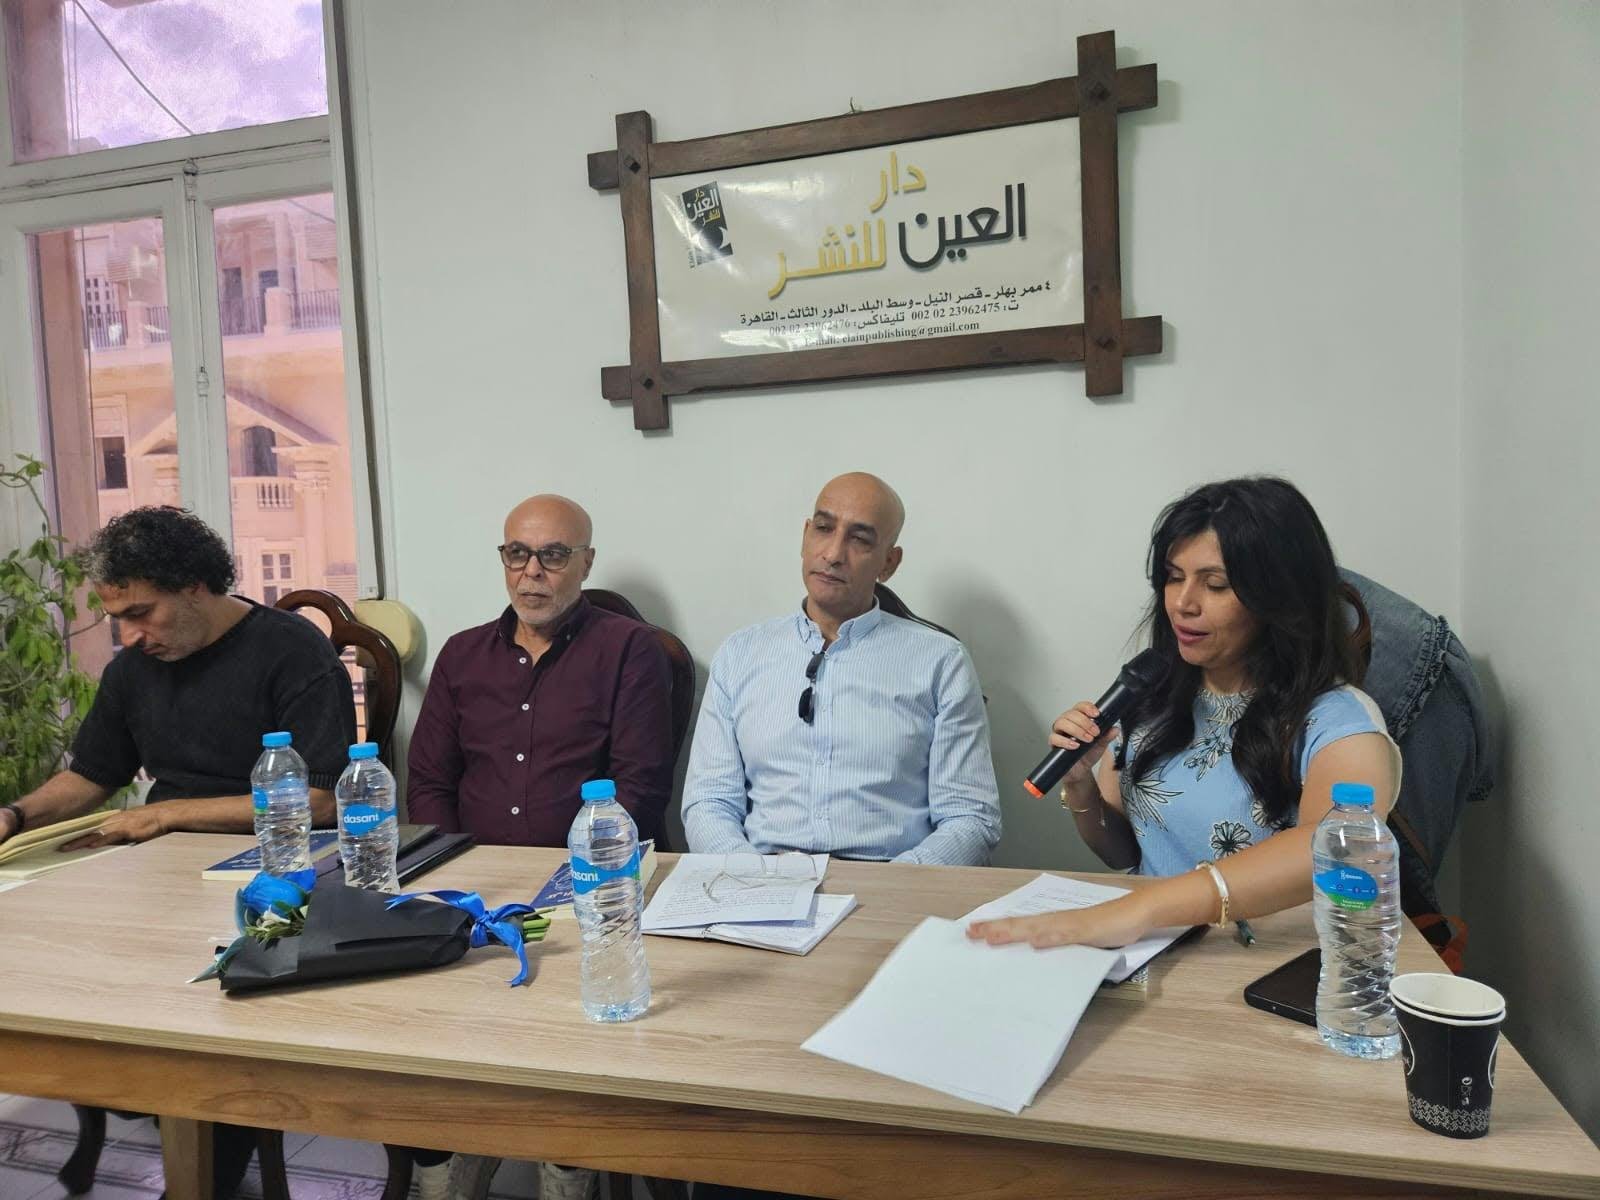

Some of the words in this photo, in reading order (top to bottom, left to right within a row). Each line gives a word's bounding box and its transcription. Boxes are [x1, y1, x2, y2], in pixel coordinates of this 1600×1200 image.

[869, 151, 927, 214] دار
[694, 188, 705, 203] دار
[685, 188, 720, 222] العين
[898, 182, 1027, 272] العين
[768, 217, 887, 299] للنشر
[955, 287, 983, 303] قصر
[993, 285, 1017, 299] بهلر
[1019, 283, 1042, 297] ممر
[858, 299, 883, 312] البلد
[886, 298, 914, 309] وسط
[923, 292, 952, 307] النيل
[787, 306, 818, 320] الثالث
[822, 303, 849, 318] الدور
[911, 310, 930, 321] 002
[933, 308, 946, 318] 02
[949, 302, 1000, 317] 23962475
[740, 311, 778, 326] القاهرة
[343, 812, 380, 824] dasani
[571, 869, 600, 883] asani
